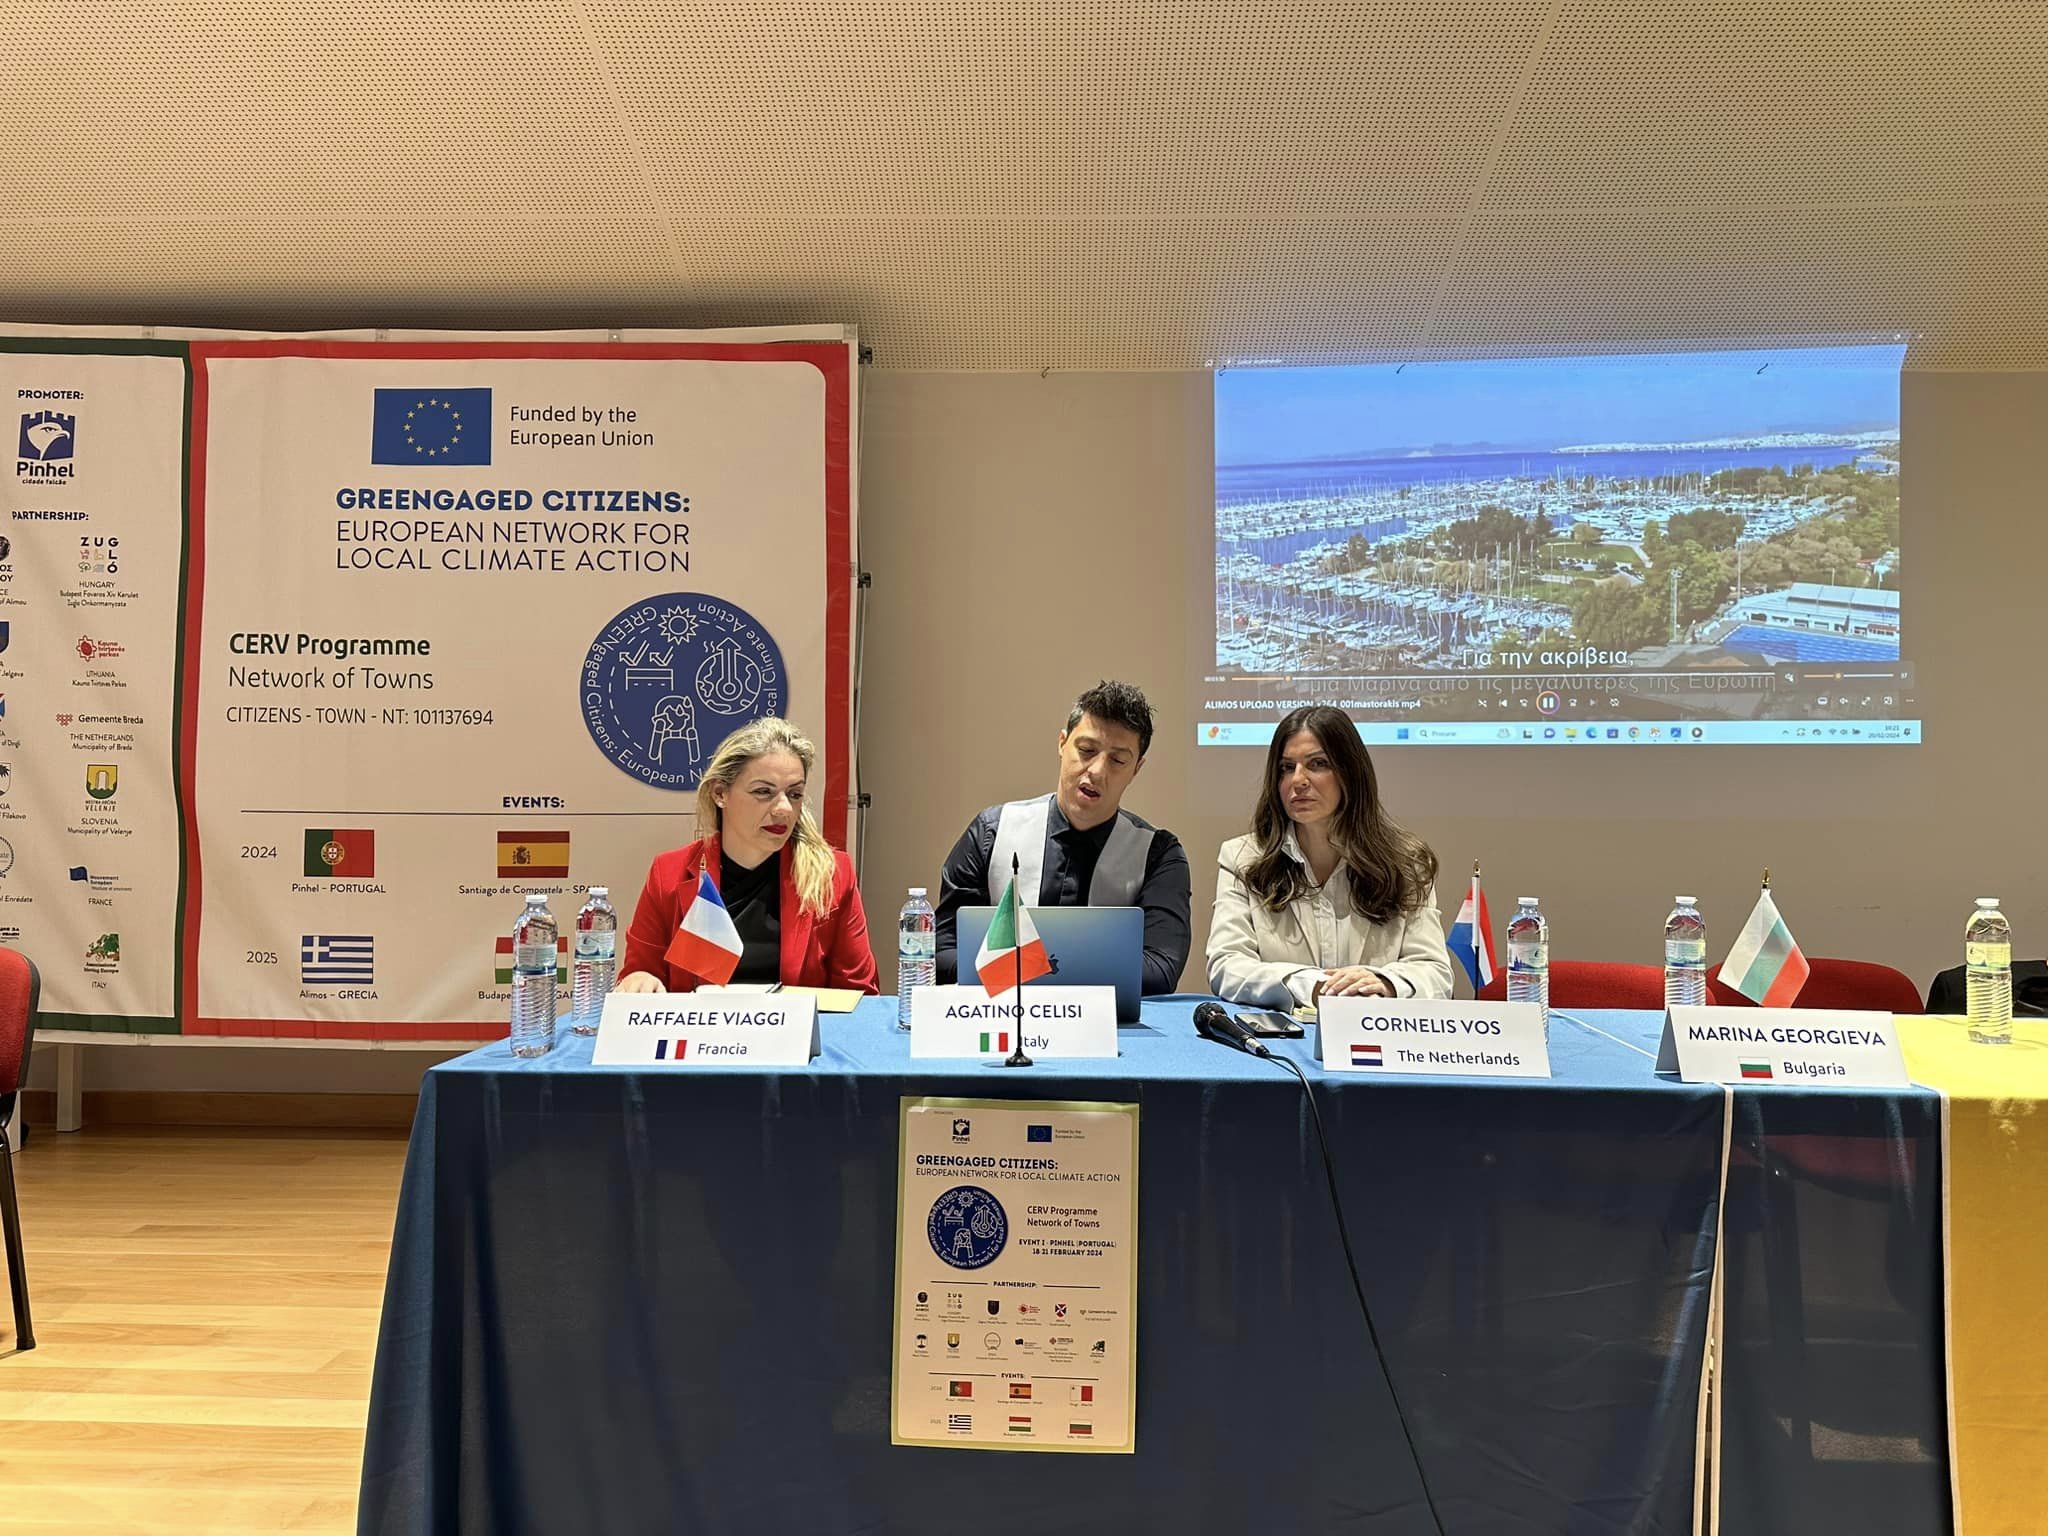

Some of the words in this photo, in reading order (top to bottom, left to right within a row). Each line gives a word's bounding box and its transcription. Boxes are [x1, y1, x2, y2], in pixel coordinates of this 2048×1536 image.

[18, 390, 84, 400] PROMOTER:
[510, 406, 576, 423] Funded
[582, 406, 603, 428] by
[608, 407, 637, 423] the
[510, 430, 596, 449] European
[602, 430, 655, 446] Union
[16, 462, 75, 478] Pinhel
[336, 488, 533, 512] GREENGAGED
[542, 490, 691, 513] CITIZENS:
[12, 511, 89, 521] PARTNERSHIP:
[337, 520, 484, 543] EUROPEAN
[494, 522, 626, 545] NETWORK
[634, 524, 689, 545] FOR
[337, 548, 432, 570] LOCAL
[442, 549, 565, 571] CLIMATE
[576, 550, 690, 573] ACTION
[230, 634, 290, 654] CERV
[298, 634, 431, 660] Programme
[1462, 650, 1493, 666] Για
[1499, 652, 1533, 669] την
[228, 666, 325, 688] Network
[332, 667, 355, 689] of
[361, 668, 434, 689] Towns
[1204, 700, 1238, 710] ALIMOS
[1240, 700, 1275, 710] UPLOAD
[78, 714, 122, 724] Gemeente
[123, 716, 144, 725] Breda
[226, 706, 302, 724] CITIZENS
[316, 707, 366, 724] TOWN
[382, 708, 409, 725] NT:
[414, 709, 494, 726] 101137694
[84, 734, 134, 742] NETHERLANDS
[618, 748, 685, 784] European
[502, 797, 565, 809] EVENTS:
[80, 818, 118, 826] SLOVENIA
[68, 827, 101, 837] Municipality
[241, 846, 278, 859] 2024
[292, 884, 320, 893] Pinhel
[330, 884, 386, 894] PORTUGAL
[459, 885, 498, 897] Santiago
[500, 885, 511, 894] de
[513, 885, 563, 896] Compostela
[88, 898, 113, 907] FRANCE
[246, 951, 278, 964] 2025
[300, 990, 328, 999] Alimos
[338, 990, 379, 1000] GRECIA
[946, 1004, 1025, 1019] AGATINO
[1030, 1004, 1082, 1019] CELISI
[628, 1012, 718, 1026] RAFFAELE
[724, 1012, 786, 1026] VIAGGI
[1361, 1016, 1457, 1034] CORNELIS
[1462, 1020, 1501, 1036] VOS
[1689, 1026, 1768, 1043] MARINA
[1771, 1028, 1886, 1046] GEORGIEVA
[698, 1043, 748, 1055] Francia
[1397, 1050, 1425, 1063] The
[1429, 1050, 1520, 1066] Netherlands
[1784, 1062, 1846, 1077] Bulgaria
[916, 1154, 996, 1168] GREENGAGED
[999, 1158, 1059, 1171] CITIZENS:
[916, 1168, 960, 1177] EUROPEAN
[960, 1170, 999, 1179] NETWORK
[1000, 1170, 1017, 1180] FOR
[1018, 1172, 1047, 1181] LOCAL
[1048, 1172, 1085, 1182] CLIMATE
[1086, 1173, 1121, 1183] ACTION
[1027, 1206, 1049, 1215] CERV
[1050, 1206, 1098, 1217] Programme
[1027, 1218, 1062, 1227] Network
[1064, 1218, 1073, 1227] of
[1075, 1218, 1100, 1228] Towns
[1050, 1248, 1086, 1256] FEBRUARY
